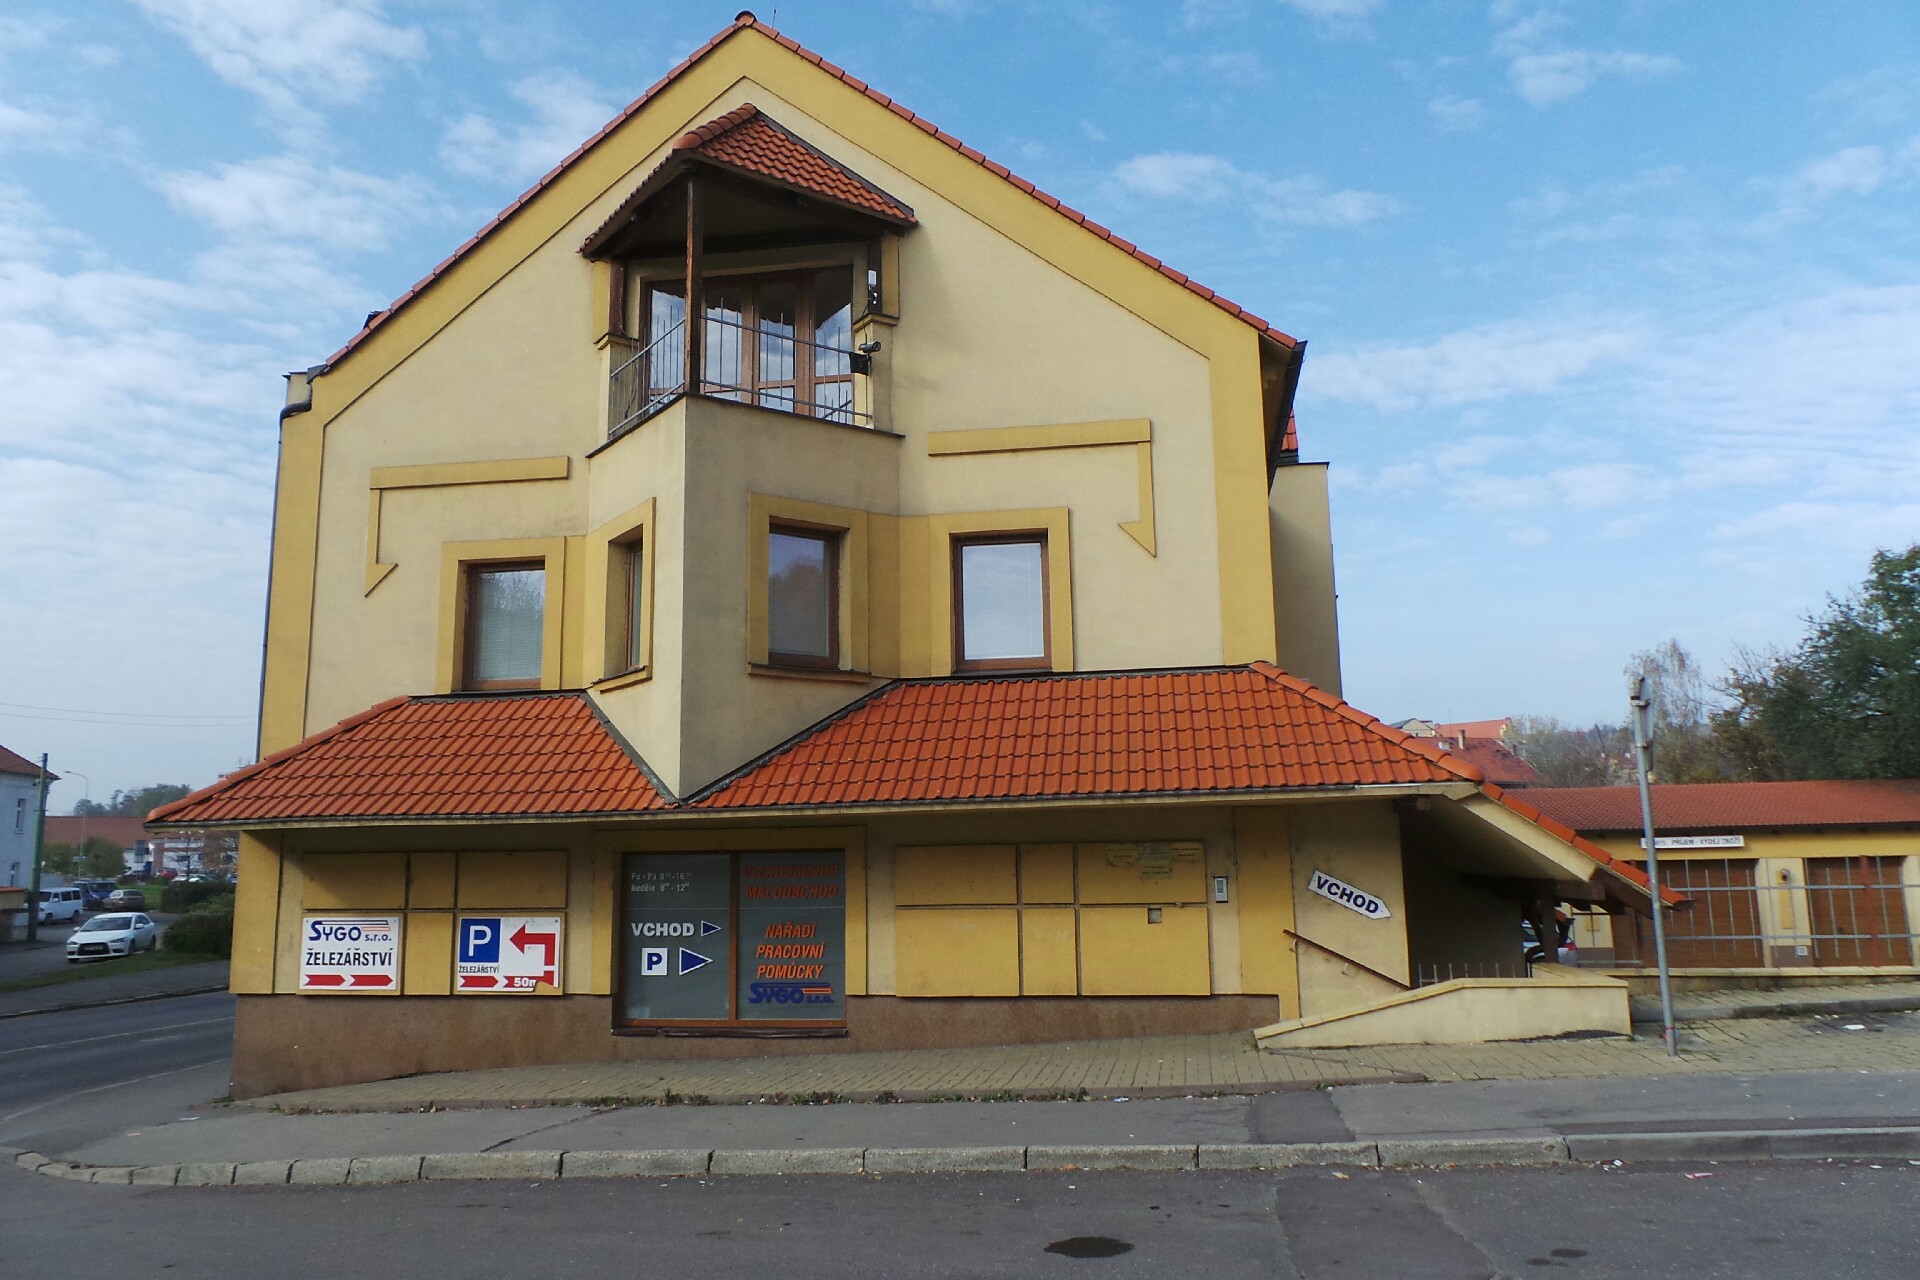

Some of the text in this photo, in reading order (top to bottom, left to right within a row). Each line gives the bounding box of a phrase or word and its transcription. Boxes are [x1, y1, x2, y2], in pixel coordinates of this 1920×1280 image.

[745, 883, 839, 899] MALOOBCHOD
[1316, 875, 1379, 914] VCHOD
[308, 920, 392, 942] SYGO s.r.o.
[630, 922, 695, 937] VCHOD
[765, 921, 817, 939] NÁŘADÍ
[468, 925, 492, 957] P
[306, 947, 394, 967] ŽELEZÁŘSTVÍ
[756, 942, 826, 959] PRACOVNÍ
[458, 963, 500, 974] ŽELEZÁŘSTVÍ
[646, 953, 663, 971] P
[756, 961, 824, 980] POMŮCKY
